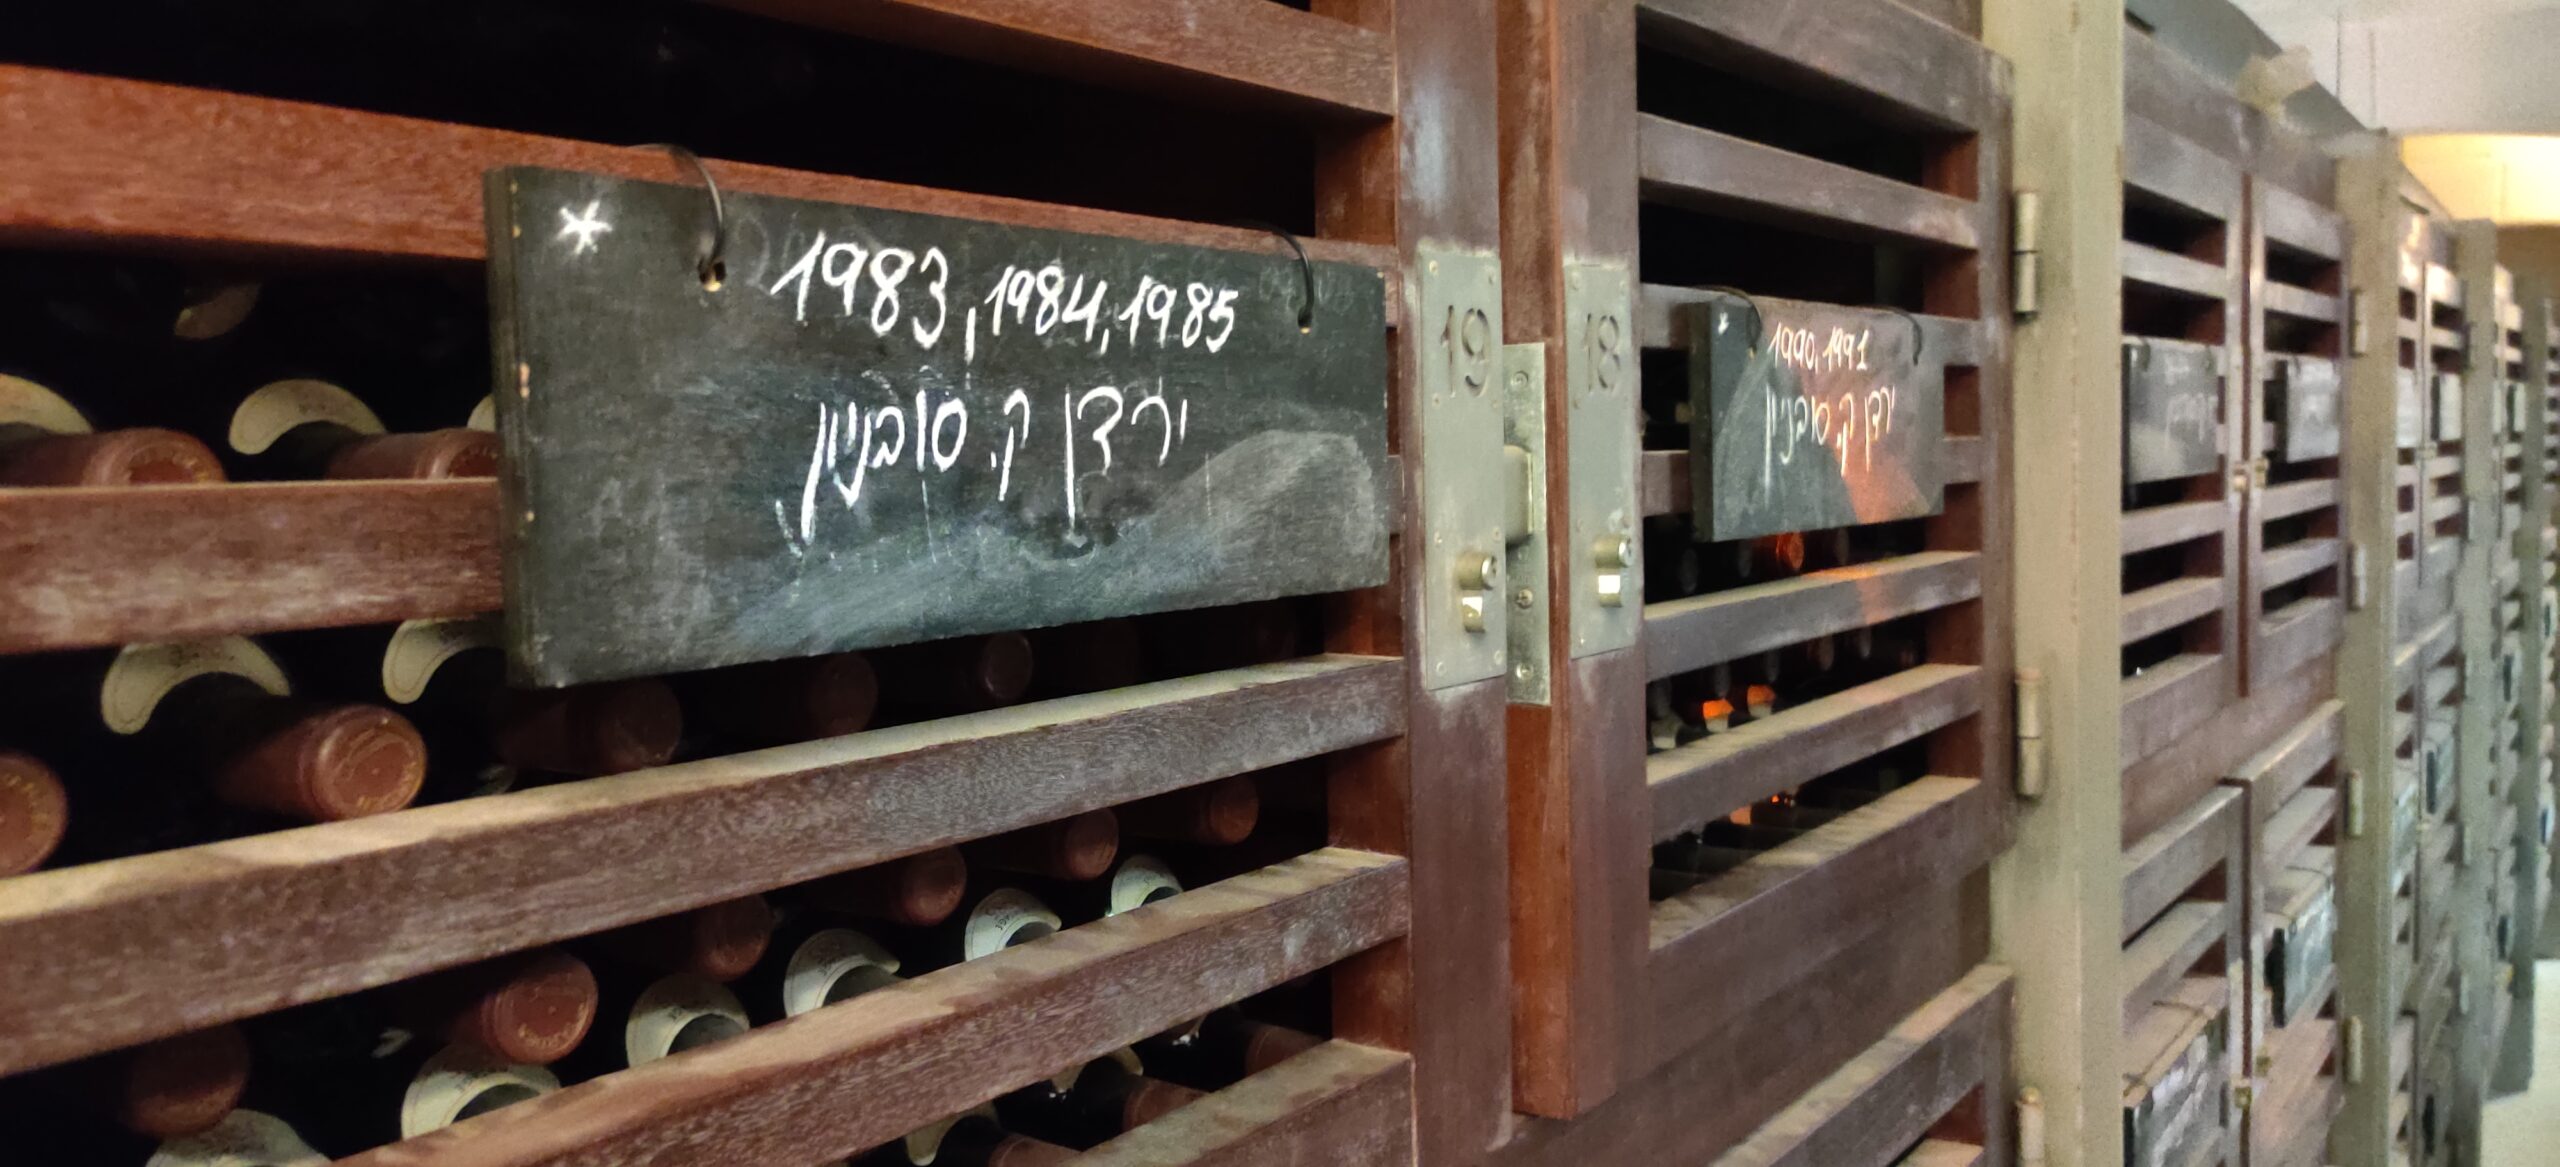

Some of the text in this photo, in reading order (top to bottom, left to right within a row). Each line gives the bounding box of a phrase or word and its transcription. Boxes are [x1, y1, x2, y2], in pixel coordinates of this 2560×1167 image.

[1441, 304, 1492, 399] 19
[1583, 312, 1622, 392] 18
[1064, 384, 1188, 548] ירדן
[1863, 385, 1896, 474] ירדן
